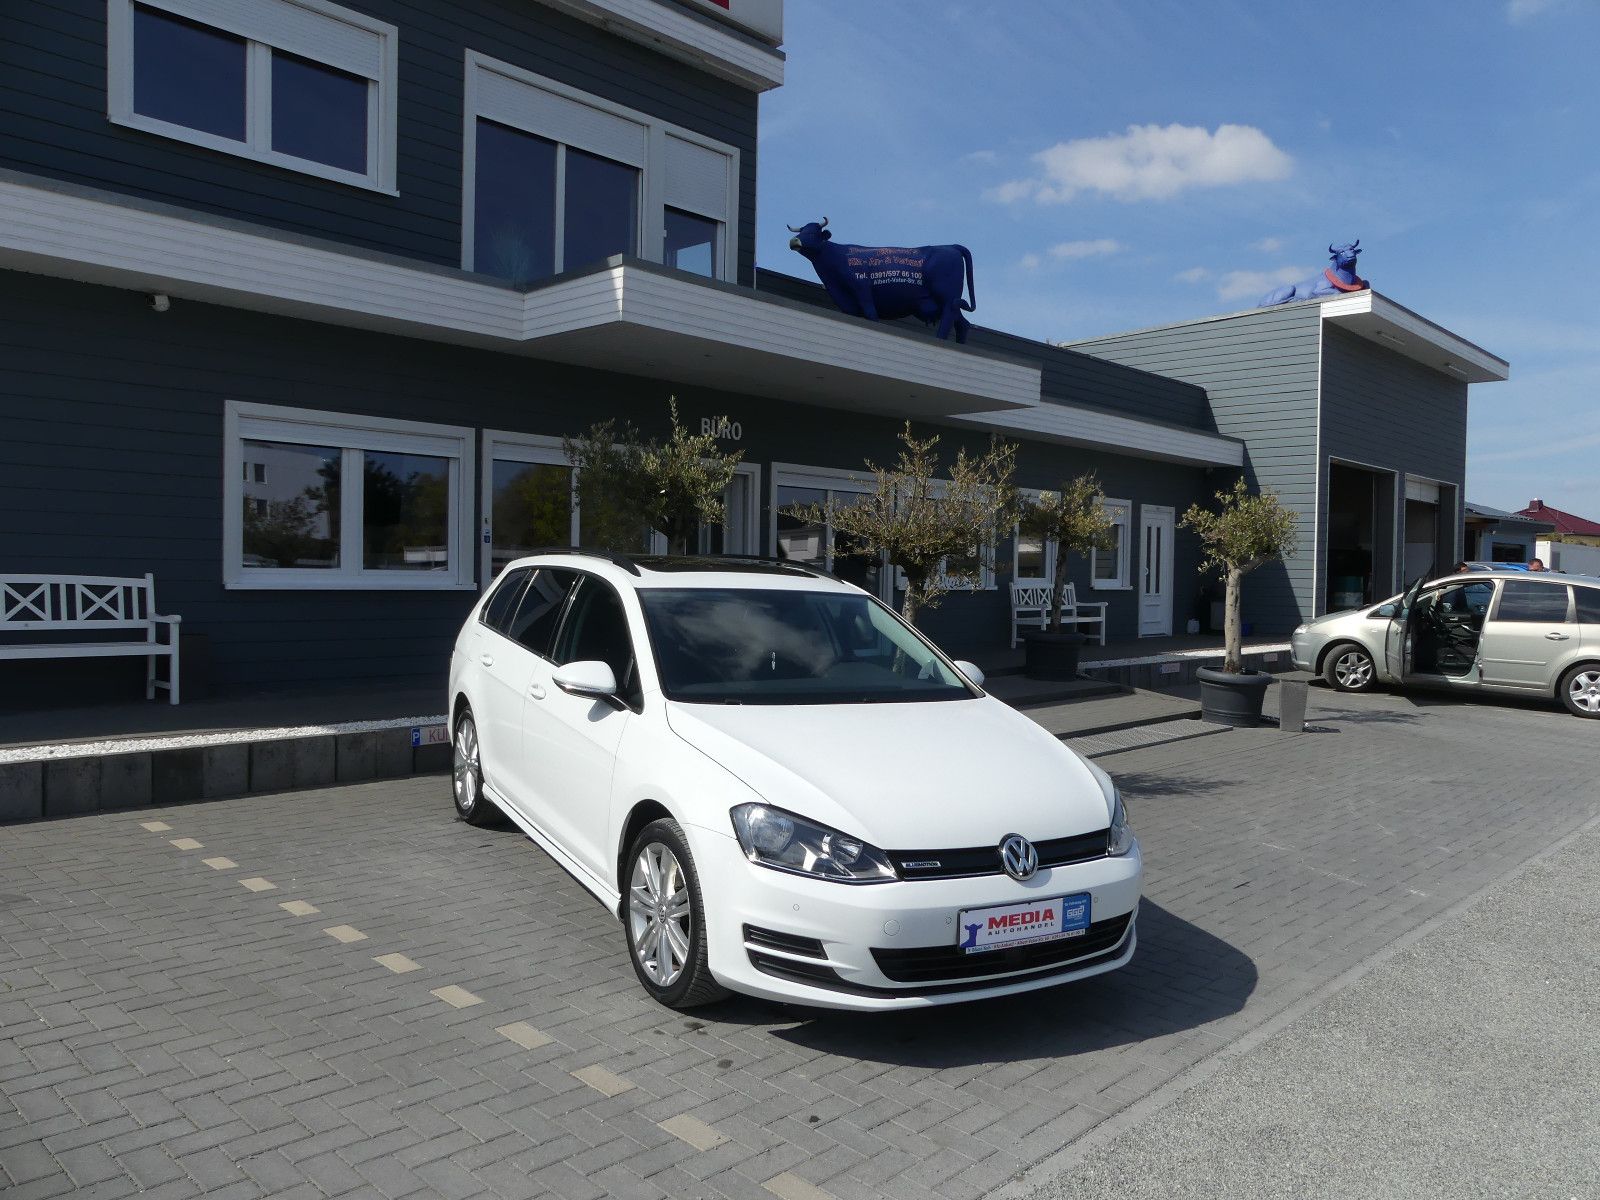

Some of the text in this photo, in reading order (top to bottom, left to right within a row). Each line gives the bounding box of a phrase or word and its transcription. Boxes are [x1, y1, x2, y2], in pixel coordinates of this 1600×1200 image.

[855, 272, 868, 280] Tel.
[701, 416, 742, 441] BÜRO
[988, 908, 1055, 930] MEDIA
[987, 921, 1055, 936] AUTOHANDEL
